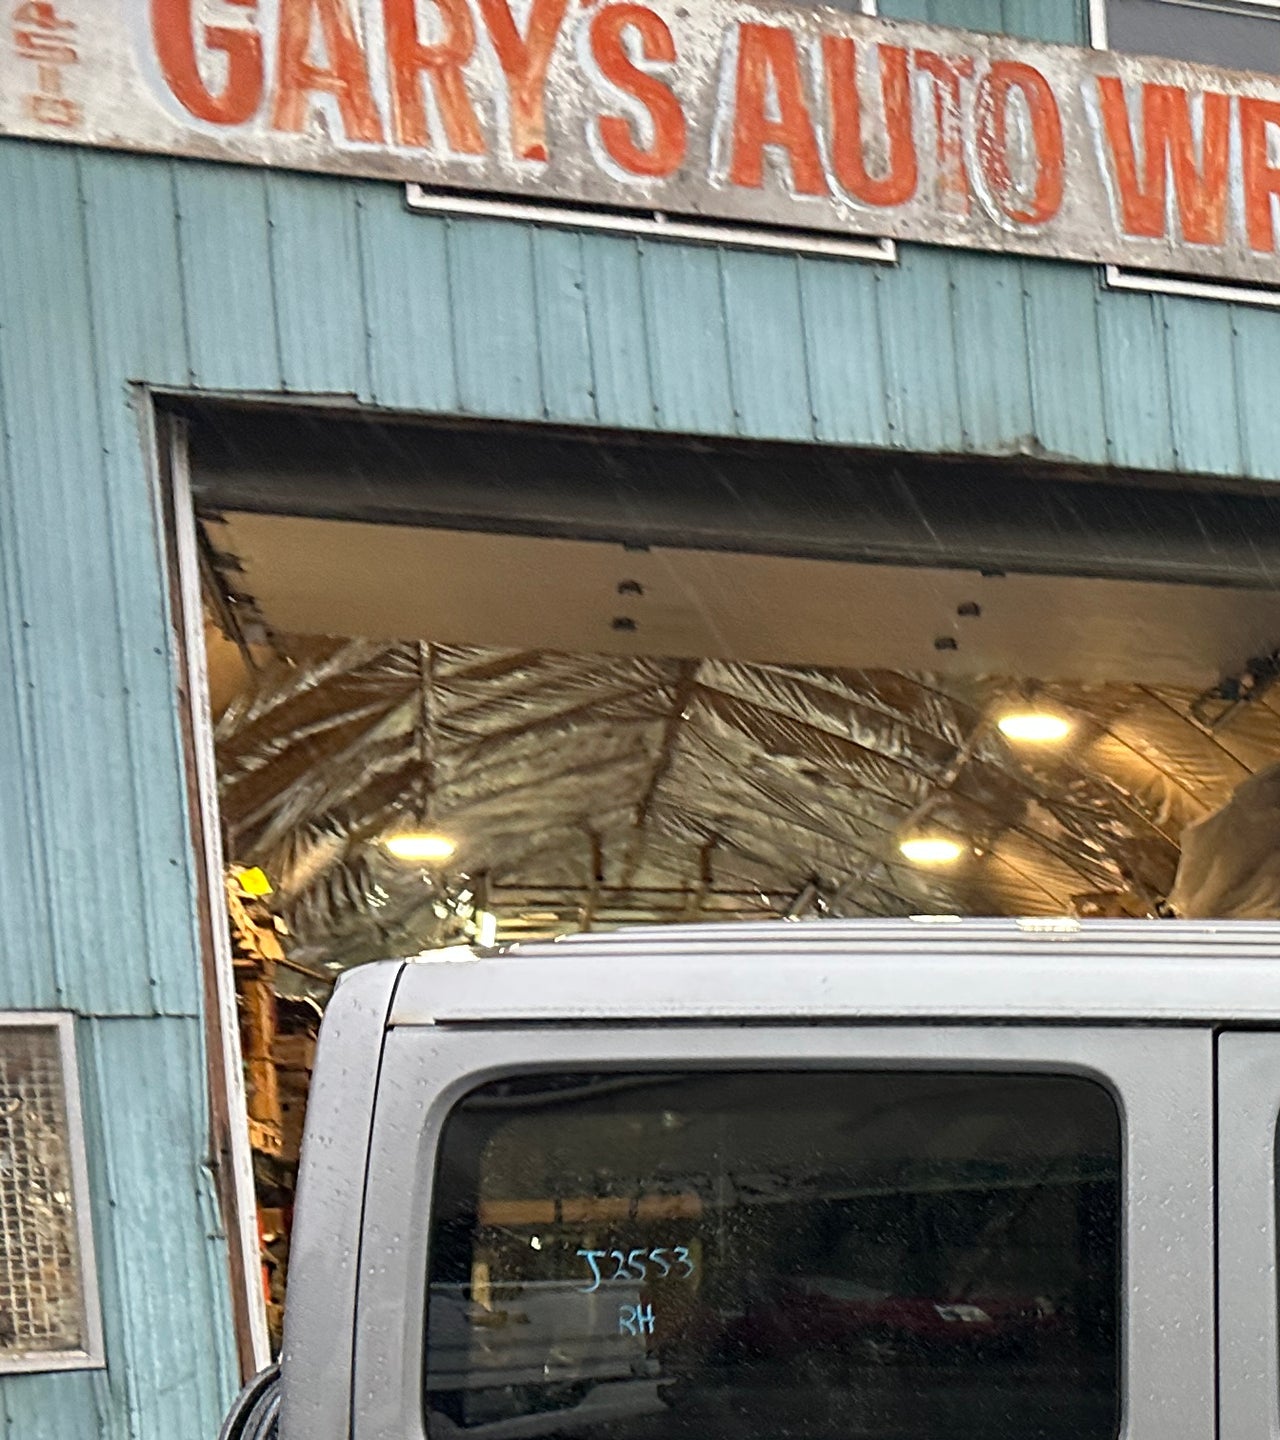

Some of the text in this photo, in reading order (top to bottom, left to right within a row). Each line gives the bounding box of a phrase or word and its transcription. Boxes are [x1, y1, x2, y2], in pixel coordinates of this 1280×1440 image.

[728, 22, 1066, 226] AUTO
[576, 1246, 696, 1294] J2553
[619, 1303, 656, 1336] RH
